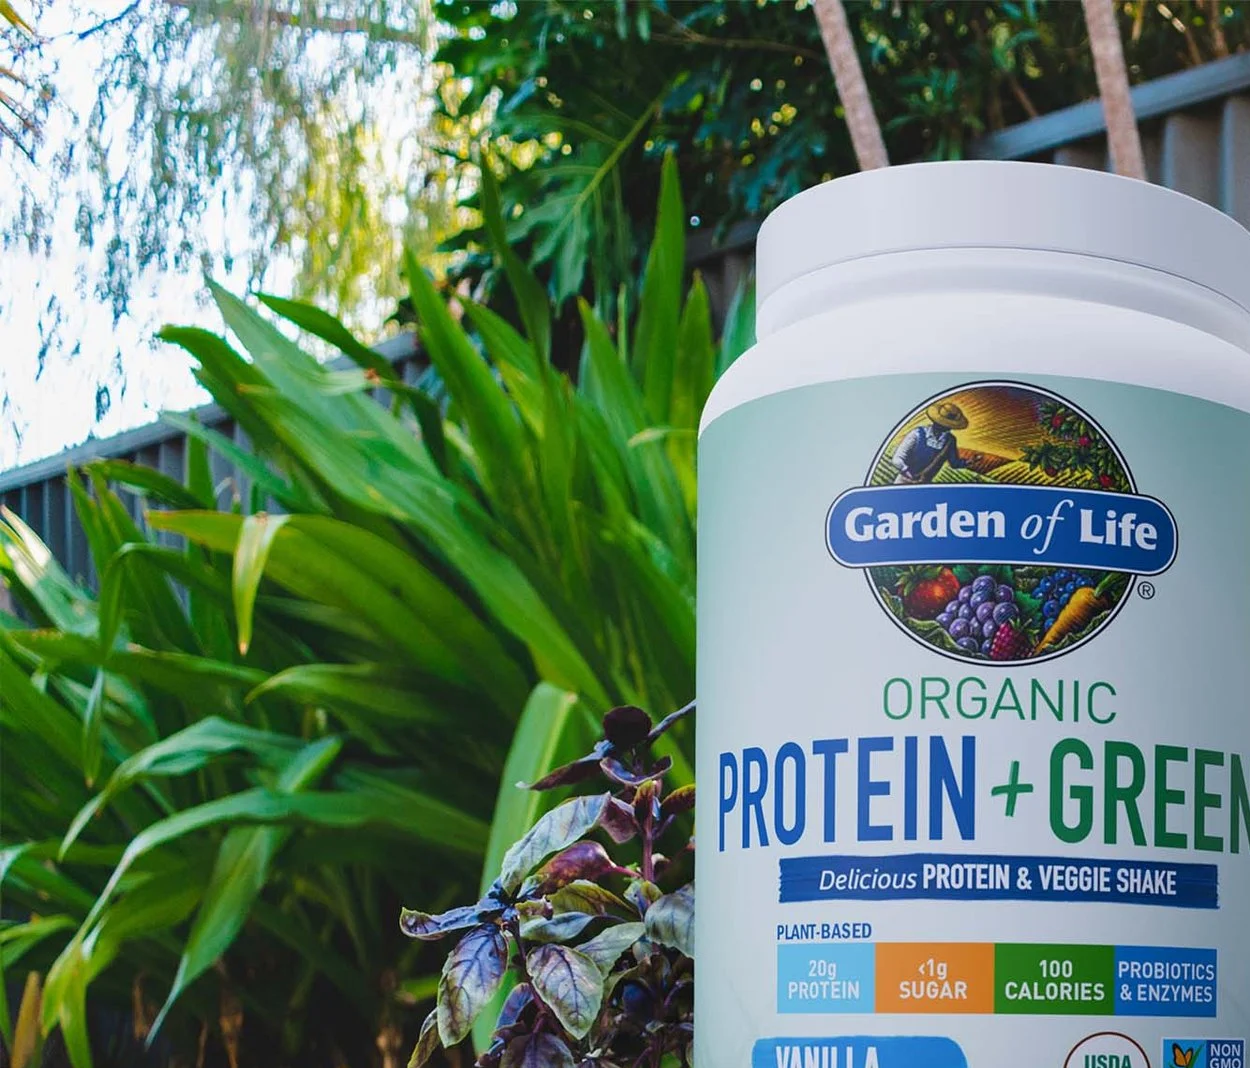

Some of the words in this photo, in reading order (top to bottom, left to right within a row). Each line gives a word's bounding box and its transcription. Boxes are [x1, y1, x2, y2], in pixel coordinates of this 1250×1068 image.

[845, 503, 1005, 542] Garden
[1020, 500, 1073, 554] of
[1081, 508, 1158, 551] Life
[883, 677, 1117, 725] ORGANIC
[719, 735, 976, 853] PROTEIN
[991, 760, 1034, 817] +
[819, 868, 917, 892] Delicious
[923, 864, 1009, 890] PROTEIN
[1017, 868, 1032, 890] &
[1039, 865, 1110, 893] VEGGIE
[1117, 869, 1176, 896] SHAKE
[777, 923, 872, 940] PLANT-BASED
[809, 960, 837, 980] 20g
[918, 958, 948, 980] <1g
[1039, 959, 1072, 978] 100
[1118, 961, 1215, 981] PROBIOTICS
[788, 981, 859, 999] PROTEIN
[900, 981, 967, 999] SUGAR
[1005, 982, 1104, 1000] CALORIES
[1120, 984, 1132, 1001] &
[1138, 984, 1213, 1003] ENZYMES
[1210, 1044, 1241, 1057] NON
